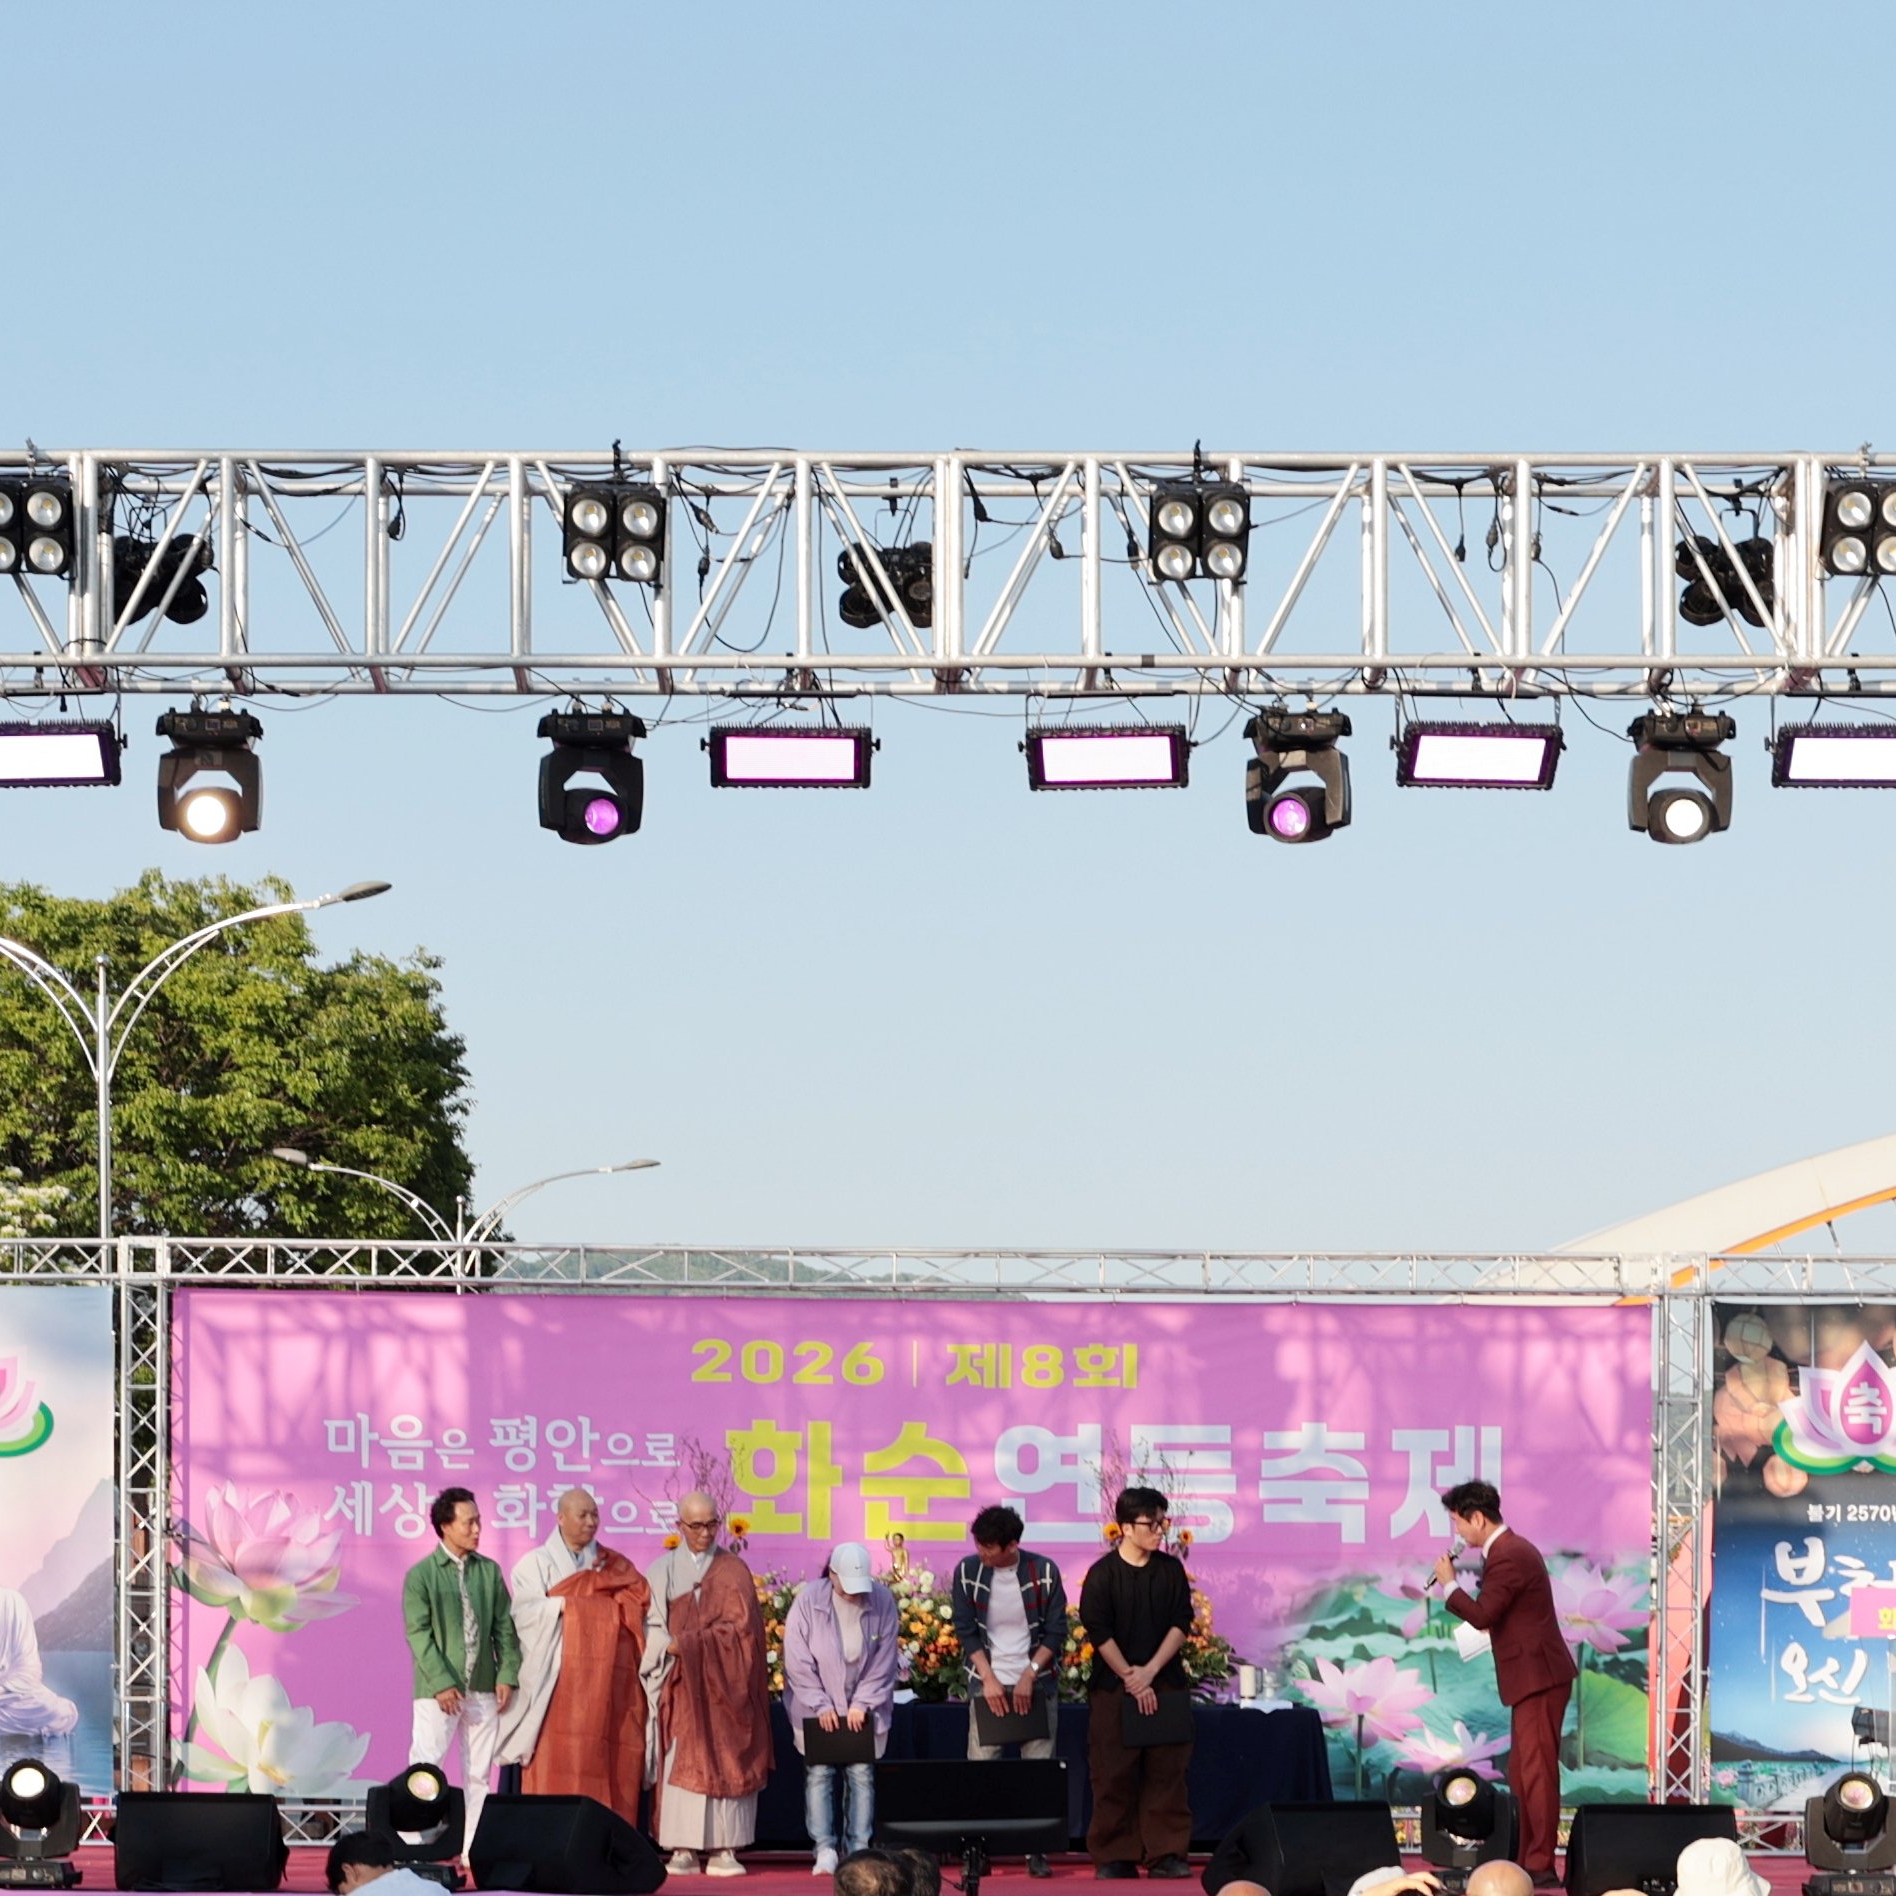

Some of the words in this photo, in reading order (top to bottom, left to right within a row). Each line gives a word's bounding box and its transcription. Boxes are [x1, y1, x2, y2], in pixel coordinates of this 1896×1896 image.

[692, 1339, 885, 1386] 2026
[945, 1342, 1139, 1390] 제8회
[1842, 1382, 1888, 1434] 축
[323, 1411, 475, 1470] 마음은
[489, 1413, 682, 1473] 평안으로
[323, 1479, 435, 1540] 세상
[724, 1419, 1504, 1545] 화순연등축제
[1807, 1504, 1841, 1523] 불기
[1780, 1641, 1869, 1706] 오신
